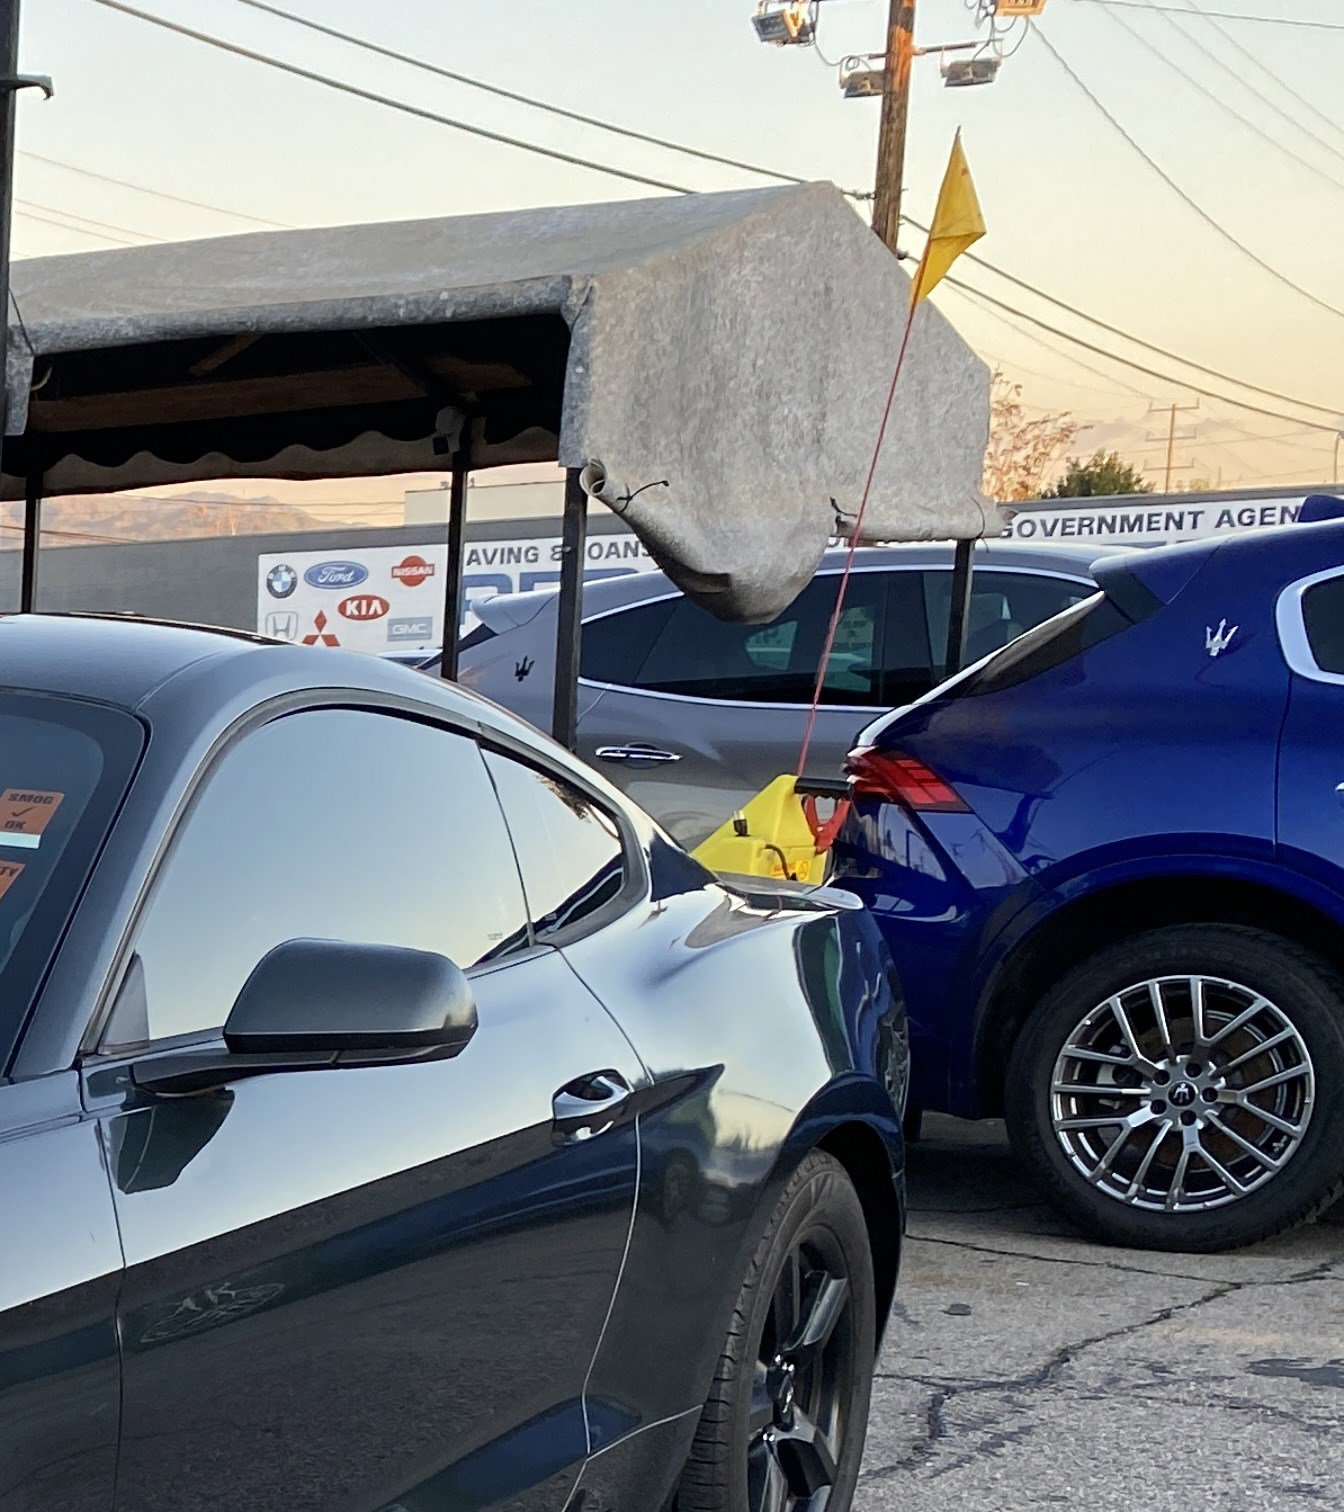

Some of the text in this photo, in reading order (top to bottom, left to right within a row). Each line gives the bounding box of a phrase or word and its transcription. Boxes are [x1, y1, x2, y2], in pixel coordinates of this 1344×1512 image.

[466, 546, 540, 566] AVING
[317, 566, 354, 583] Ford
[393, 564, 435, 577] NISSAN
[345, 600, 384, 616] KIA
[392, 623, 428, 634] GMC
[8, 793, 56, 805] SMOG
[5, 820, 26, 830] OK
